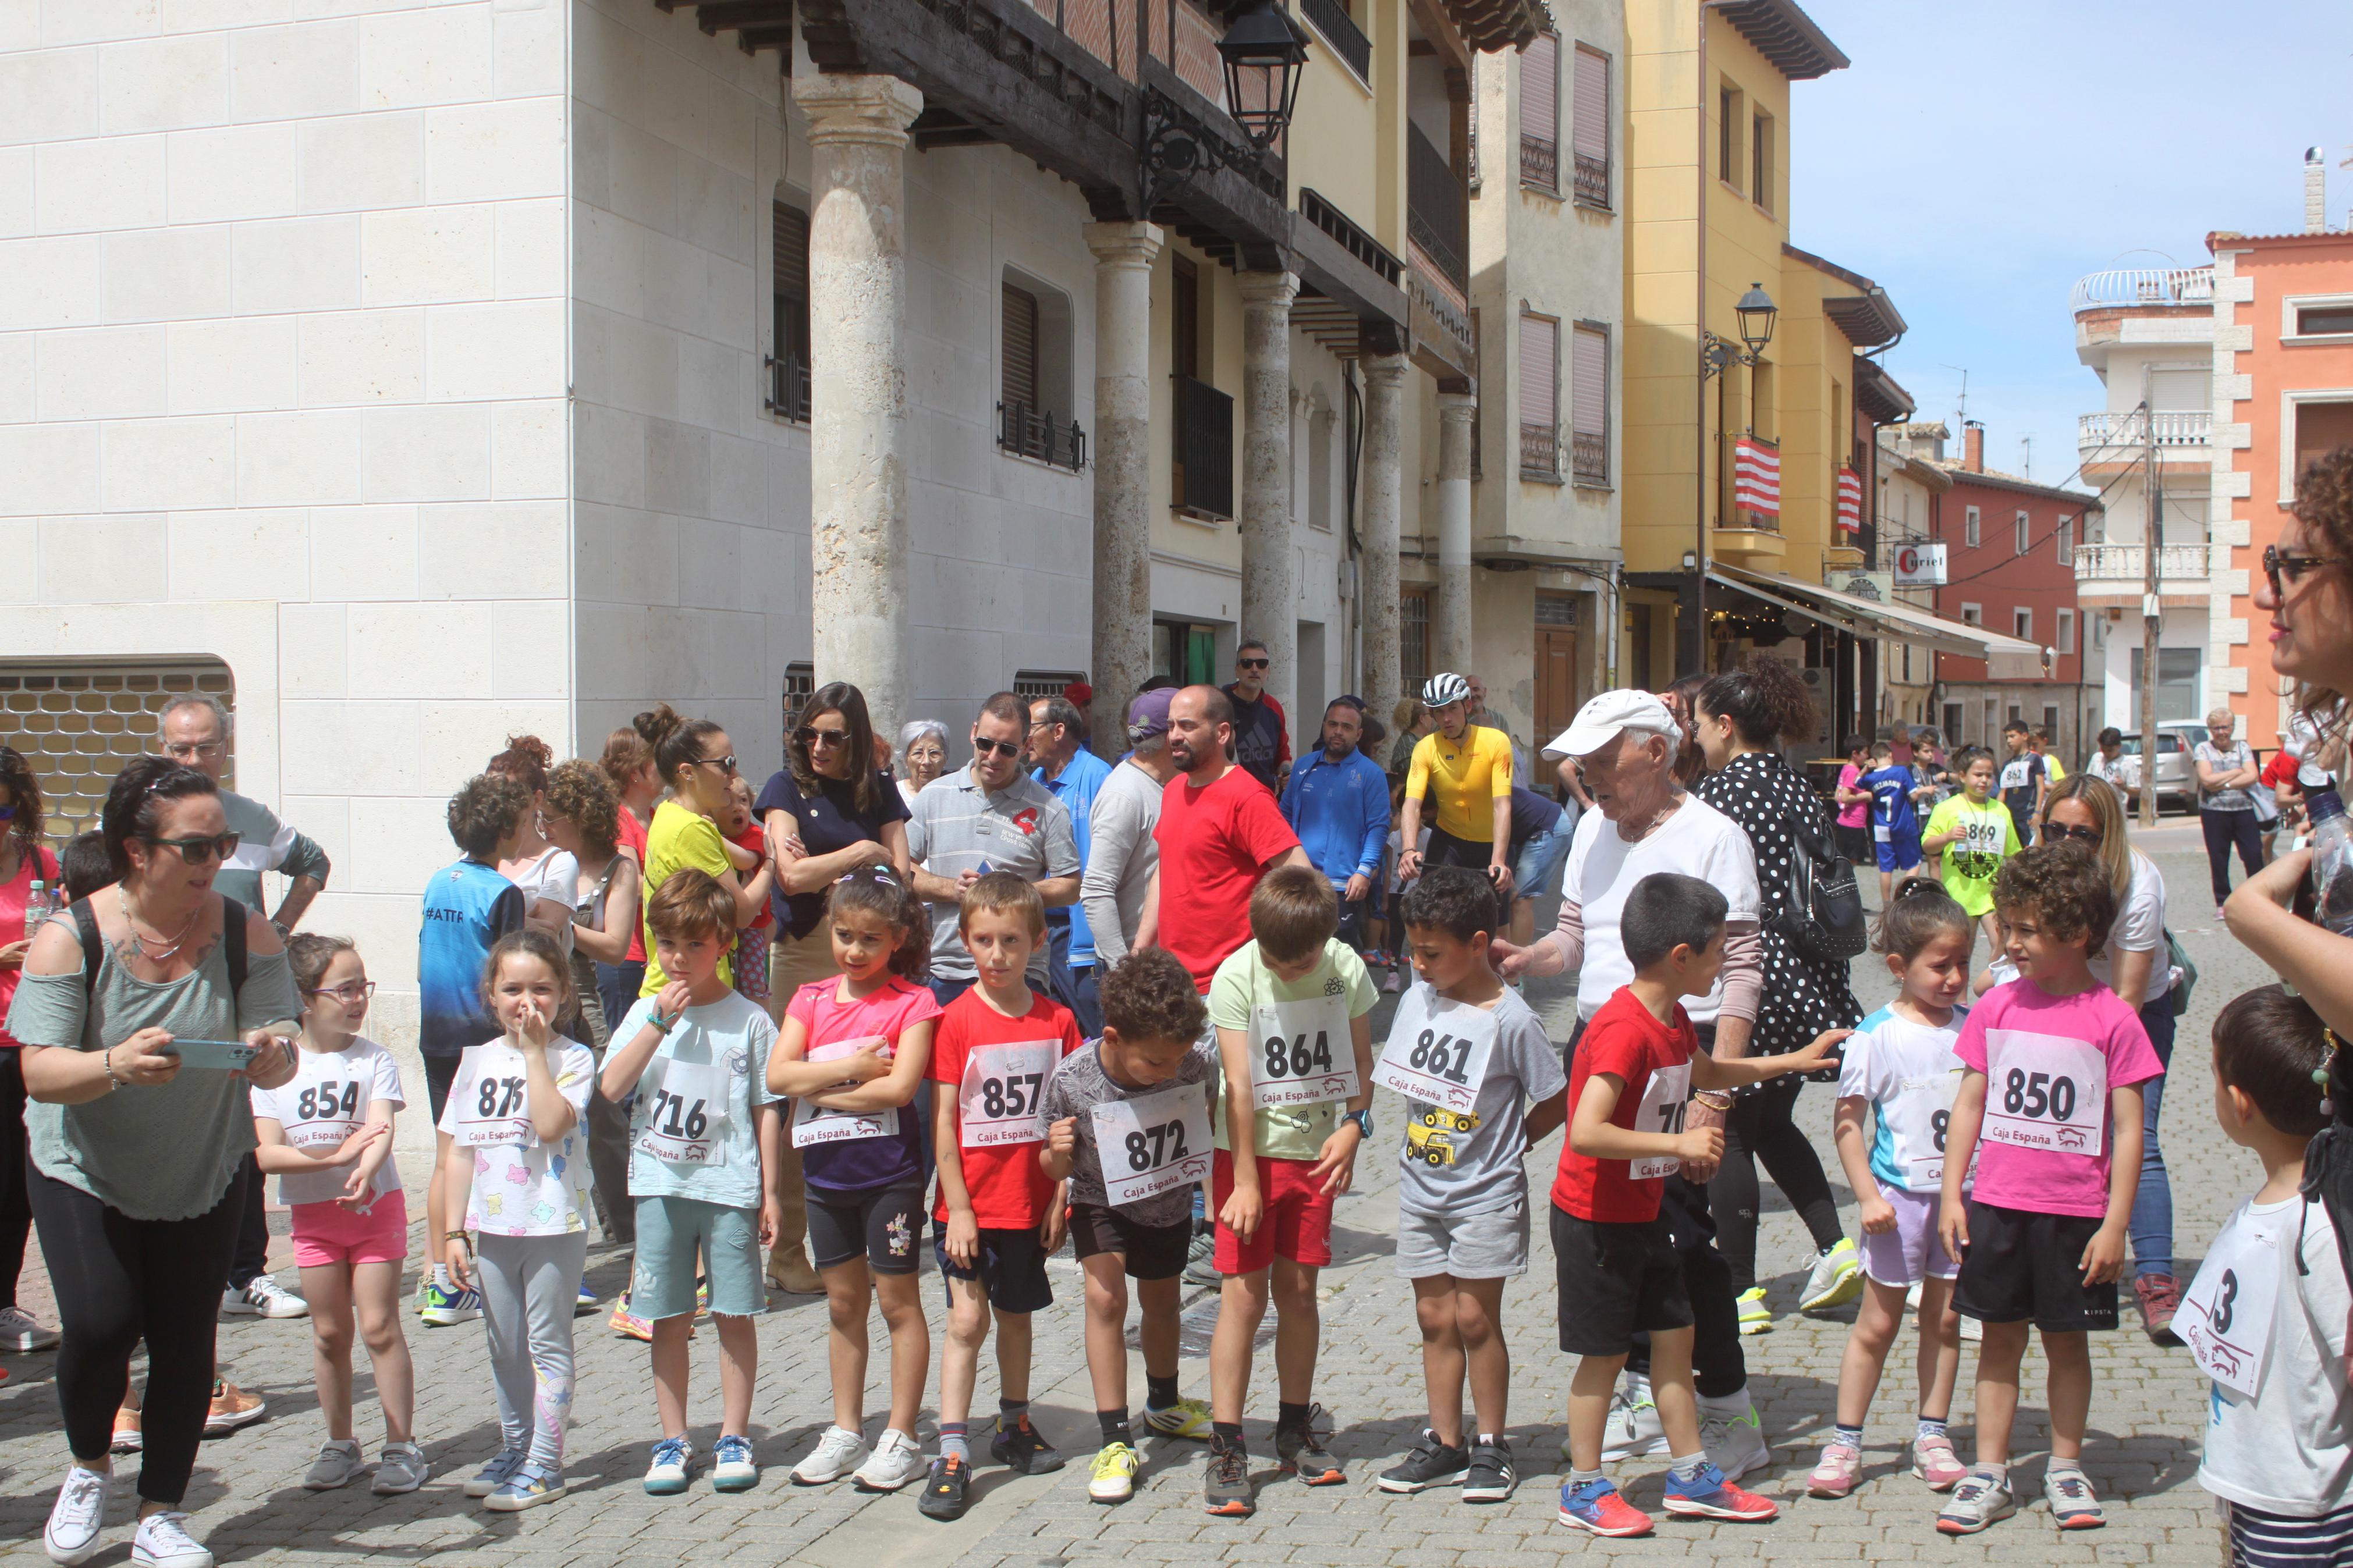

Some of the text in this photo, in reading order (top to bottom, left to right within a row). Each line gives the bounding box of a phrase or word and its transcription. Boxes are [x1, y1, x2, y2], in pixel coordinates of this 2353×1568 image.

[1899, 549, 1942, 573] Curiel
[2007, 769, 2022, 780] 862
[1968, 824, 1996, 842] 869
[1265, 1030, 1332, 1078] 864
[1410, 1029, 1473, 1085] 861
[298, 1080, 359, 1120] 854
[982, 1072, 1044, 1118] 857
[1262, 1090, 1320, 1104] Caja España
[1388, 1076, 1442, 1101] Caja España
[2004, 1068, 2075, 1122] 850
[652, 1089, 707, 1140] 716
[1659, 1100, 1687, 1135] 70
[293, 1131, 342, 1144] Caja España
[469, 1132, 486, 1143] Caja
[798, 1128, 851, 1145] Caja España
[978, 1129, 1034, 1144] Caja España
[1125, 1119, 1188, 1171] 872
[1993, 1126, 2051, 1144] Caja España
[1641, 1165, 1660, 1177] Caja
[1124, 1175, 1179, 1198] Caja España
[2213, 1268, 2238, 1335] 3
